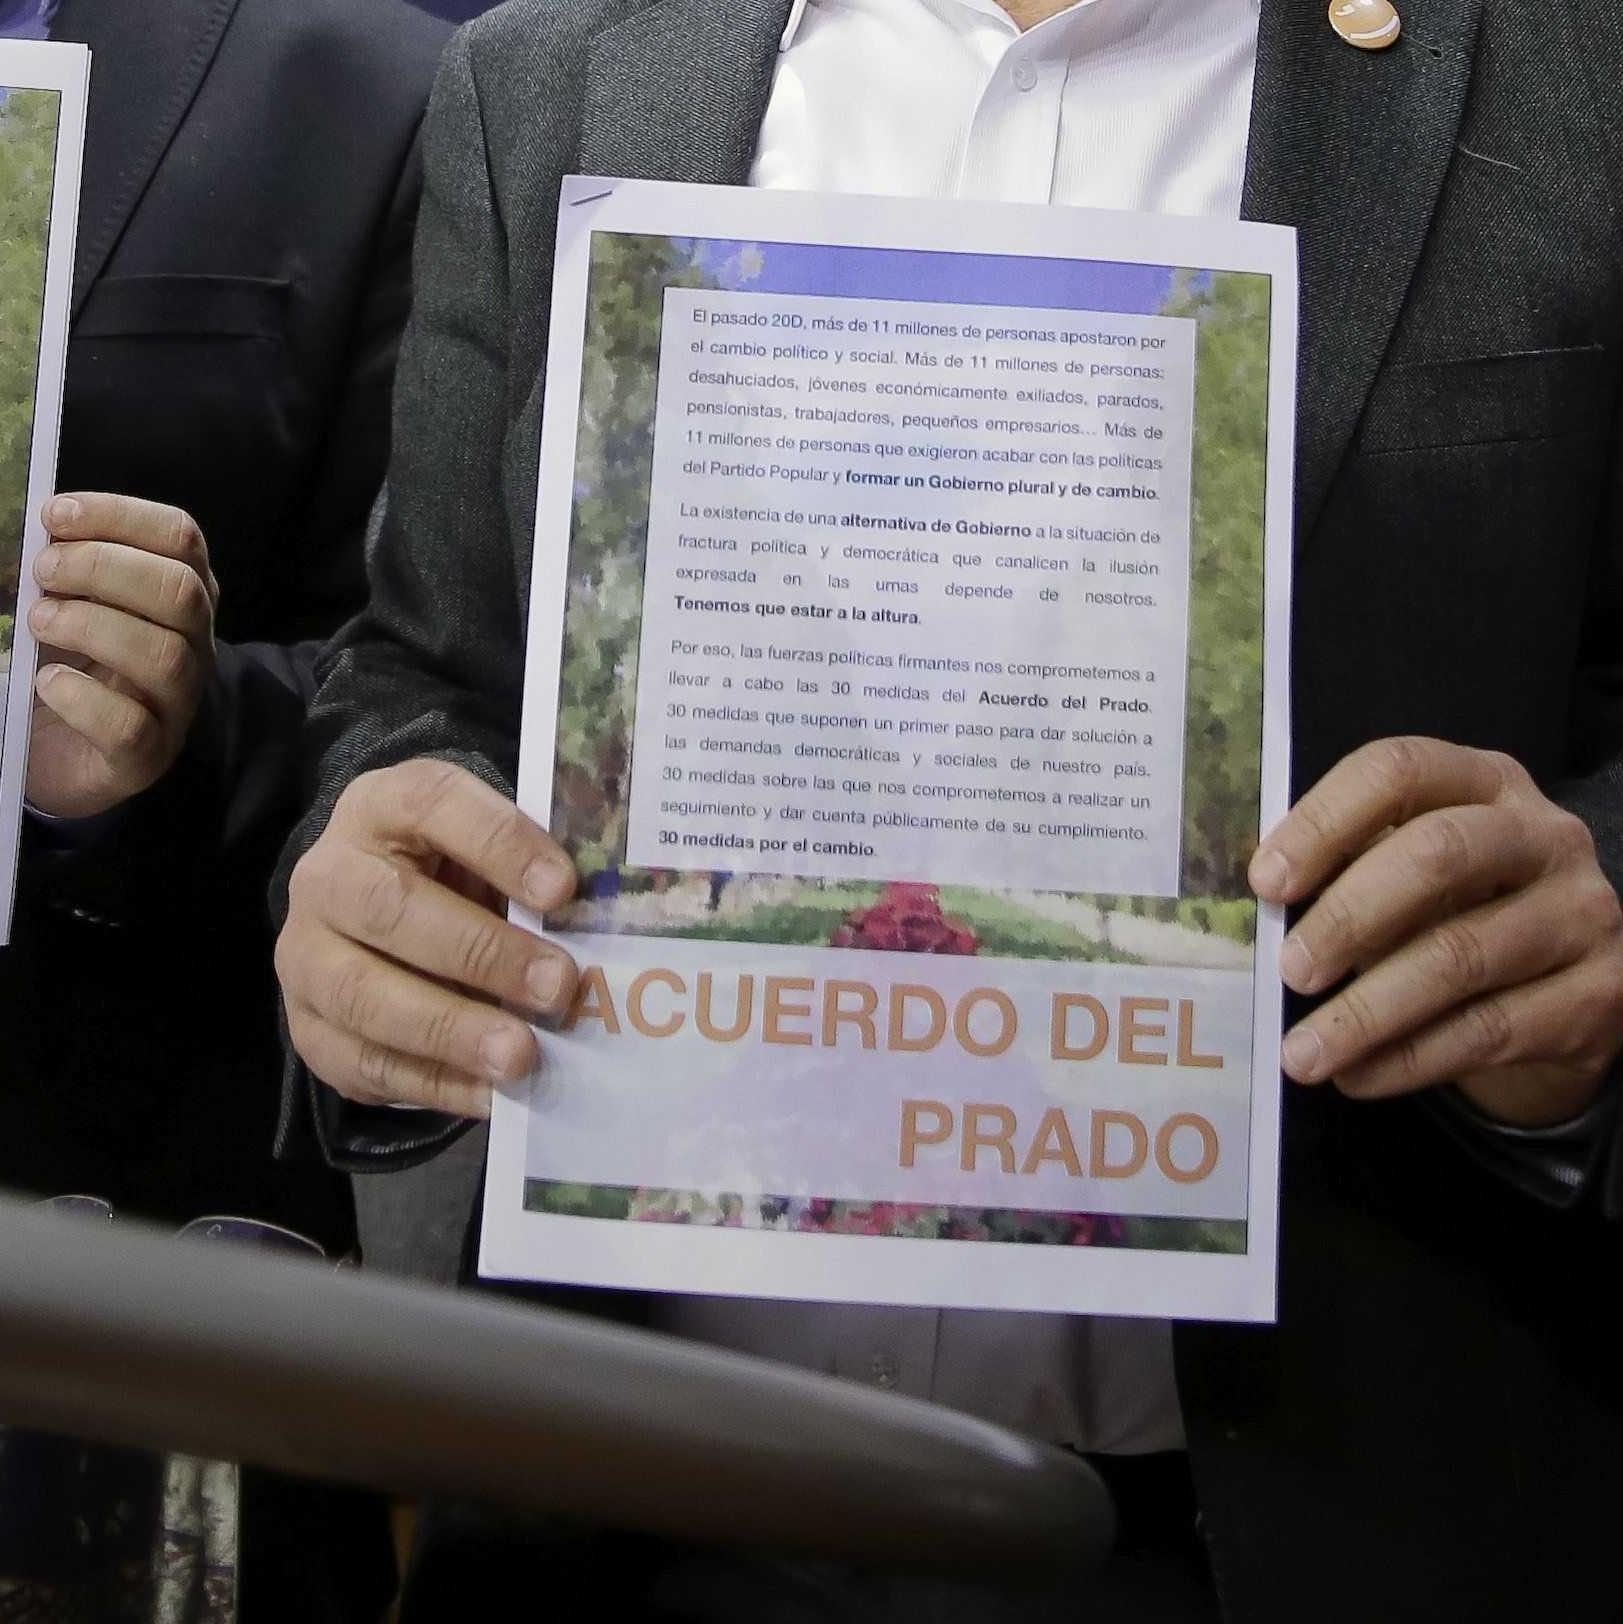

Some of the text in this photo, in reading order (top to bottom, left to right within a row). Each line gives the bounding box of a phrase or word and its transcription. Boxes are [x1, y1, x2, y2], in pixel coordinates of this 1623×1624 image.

[668, 669, 710, 687] llevar
[721, 676, 732, 689] a
[743, 675, 784, 691] cabo
[795, 677, 819, 694] las
[830, 679, 851, 696] 30
[862, 684, 930, 701] medidas
[941, 687, 966, 703] del
[977, 689, 1049, 709] Acuerdo
[1060, 694, 1087, 710] del
[666, 703, 687, 718] 30
[691, 705, 759, 722] medidas
[764, 711, 795, 727] que
[799, 713, 867, 730] suponen
[873, 718, 893, 730] un
[898, 718, 949, 736] primer
[954, 723, 993, 738] paso
[998, 725, 1034, 741] para
[1039, 724, 1066, 741] dar
[1142, 733, 1152, 746] a
[664, 733, 687, 750] las
[698, 735, 782, 755] demandas
[912, 751, 921, 768] y
[933, 752, 997, 769] sociales
[1009, 754, 1031, 771] de
[1041, 759, 1102, 775] nuestro
[661, 765, 1150, 809] 30 medidas sobre las que nos comprometemos a realizar un
[660, 799, 756, 817] seguimiento
[762, 806, 772, 821] y
[778, 803, 806, 821] dar
[811, 809, 866, 824] cuenta
[984, 816, 1006, 832] de
[1011, 821, 1032, 834] su
[658, 829, 679, 845] 30
[681, 832, 754, 849] medidas
[758, 838, 788, 853] por
[791, 837, 808, 852] el
[563, 966, 1224, 1068] ACUERDO DEL
[897, 1099, 1221, 1186] PRADO
